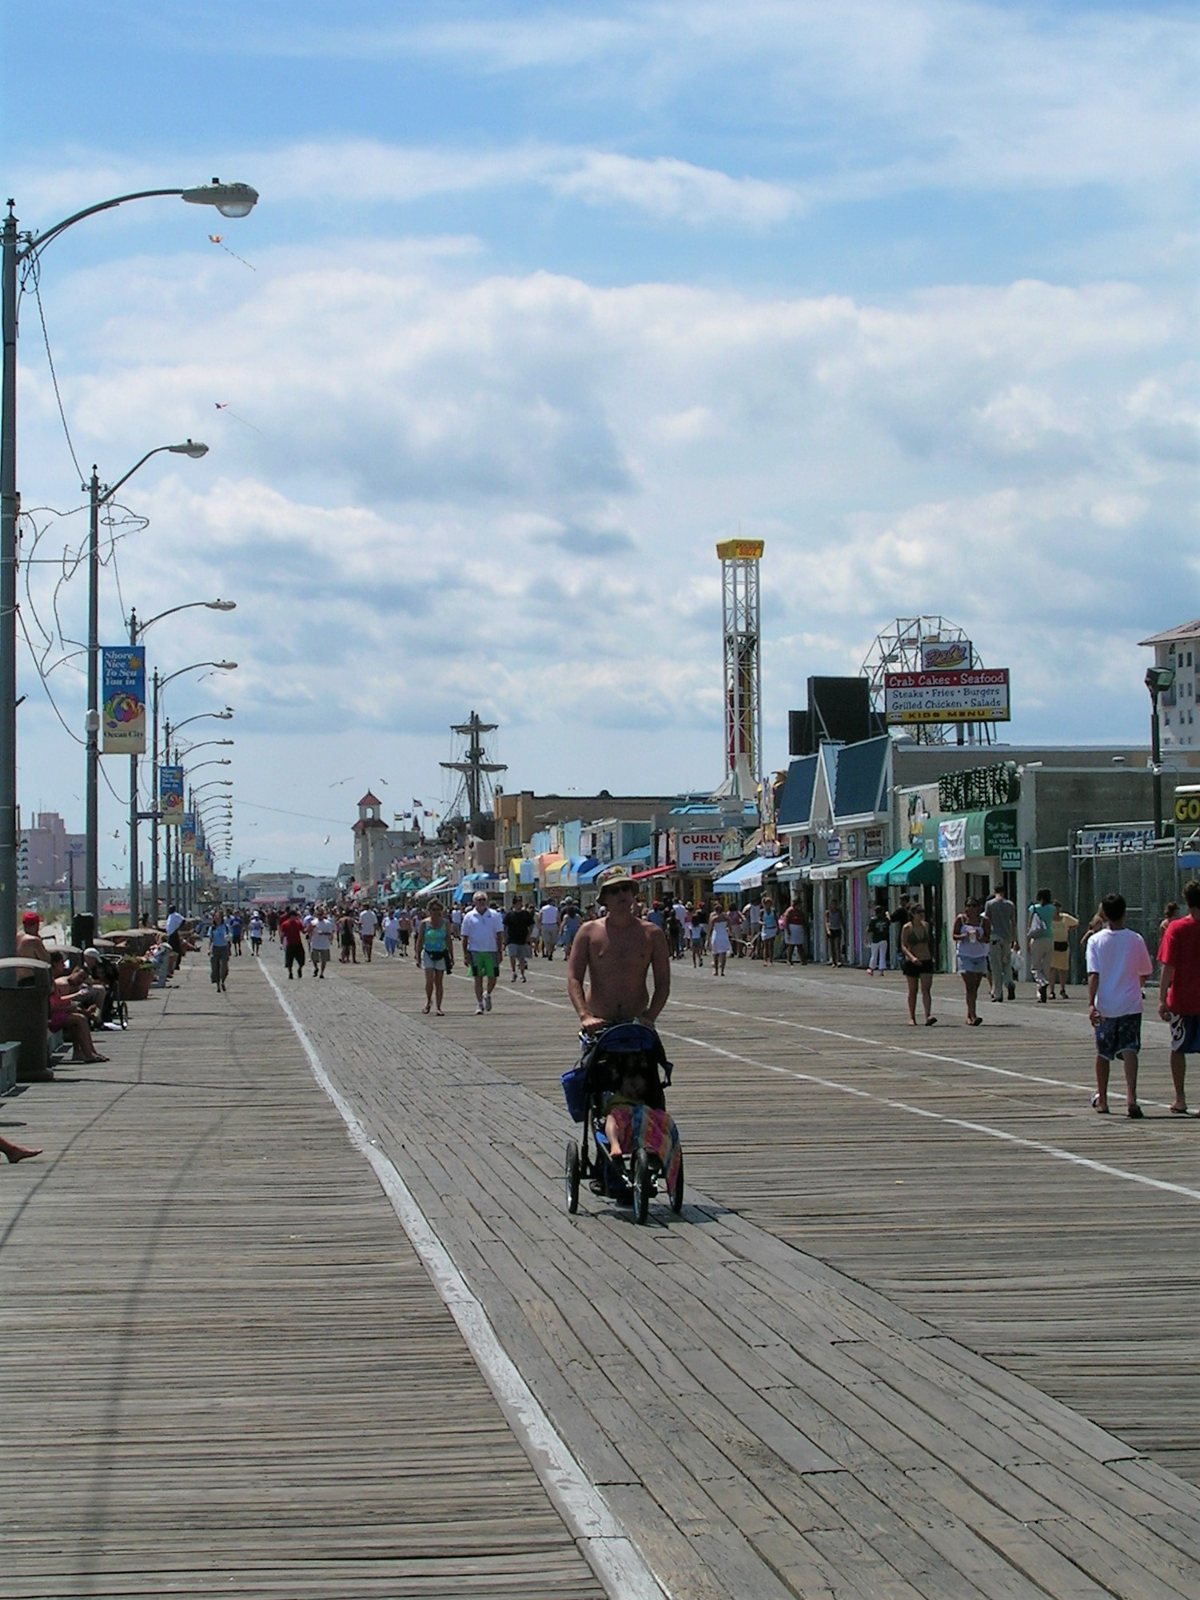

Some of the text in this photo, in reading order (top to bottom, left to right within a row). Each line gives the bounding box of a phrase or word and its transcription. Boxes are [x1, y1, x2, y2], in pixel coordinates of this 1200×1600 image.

[104, 651, 134, 660] Shore
[105, 660, 126, 668] Nice
[105, 669, 119, 677] To
[105, 677, 136, 686] You in
[889, 672, 1005, 687] Crab Cakes Seafood
[892, 688, 1000, 699] Steaks Fries Burgers
[892, 698, 1001, 711] Grilled Chicken Salads
[908, 711, 941, 719] KIDS
[947, 710, 985, 718] MENU
[104, 731, 144, 739] Ocean City
[682, 834, 724, 844] CURLY
[692, 851, 721, 861] FRIE
[1002, 852, 1021, 860] ATM
